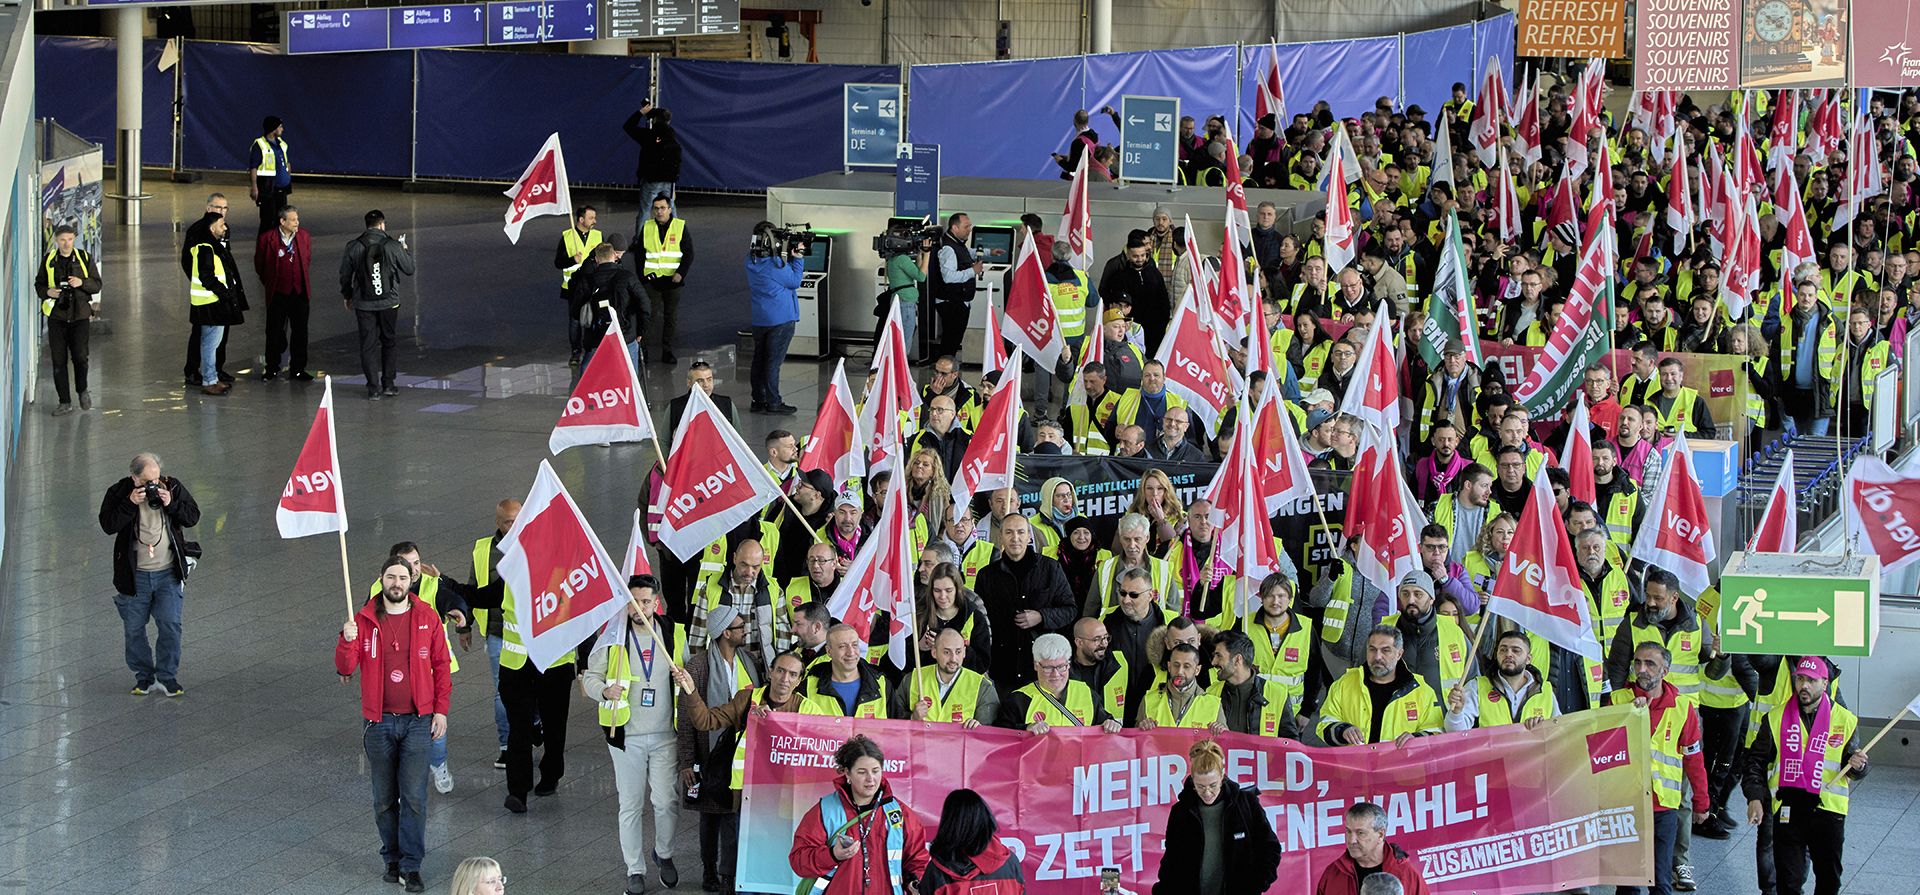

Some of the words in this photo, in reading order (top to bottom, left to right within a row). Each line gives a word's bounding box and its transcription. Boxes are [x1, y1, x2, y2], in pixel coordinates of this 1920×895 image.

[444, 8, 451, 23] B
[1525, 0, 1617, 21] REFRESH
[342, 13, 350, 27] C
[1646, 13, 1731, 30] SOUVENIRS
[1524, 25, 1617, 46] REFRESH
[1646, 31, 1731, 48] SOUVENIRS
[1645, 50, 1730, 66] SOUVENIRS
[1644, 67, 1730, 84] SOUVENIRS
[851, 128, 877, 136] Terminal
[851, 139, 866, 151] D,E
[1126, 141, 1152, 149] Terminal
[1125, 152, 1141, 165] D,E
[372, 262, 383, 295] adidas
[1076, 479, 1141, 496] FFENTLICHE
[1169, 474, 1196, 485] ENST
[1077, 493, 1134, 518] EHEN
[1800, 659, 1816, 670] dbb
[770, 735, 844, 751] TARIFRUNDE
[1786, 724, 1800, 752] dbb
[770, 748, 838, 768] ÖFFENTLIC
[883, 759, 906, 773] NST
[1072, 754, 1187, 816] MEHR
[1225, 749, 1329, 798] ELD,
[1035, 822, 1150, 881] ZEIT
[1263, 799, 1345, 853] INE
[1355, 773, 1489, 837] AHL!
[1419, 838, 1526, 878] ZUSAMMEN
[1530, 824, 1579, 857] GEHT
[1584, 813, 1638, 843] MEHR
